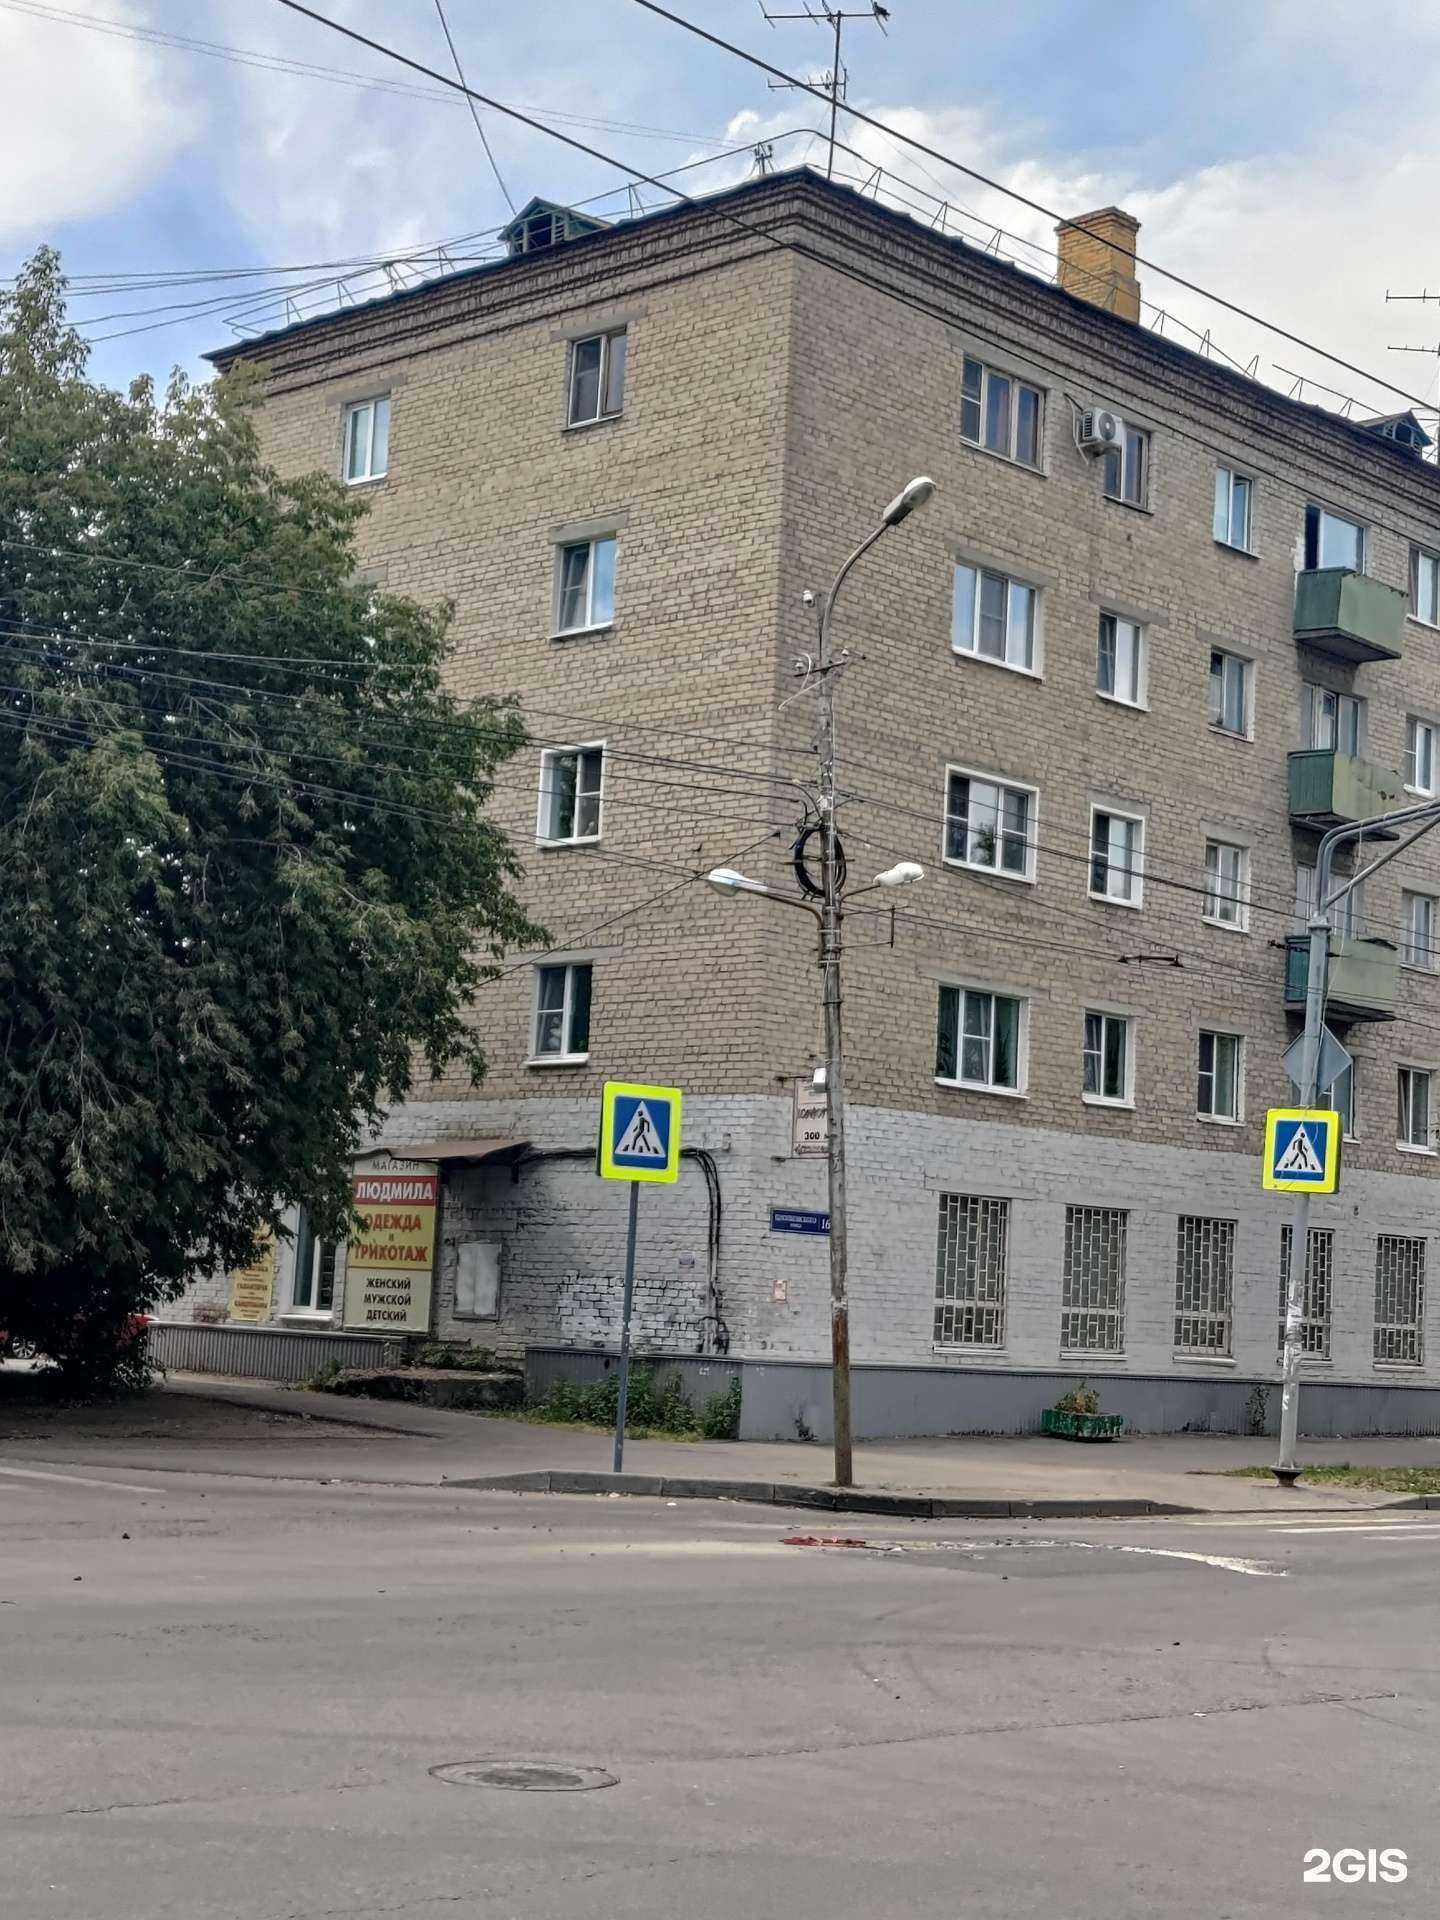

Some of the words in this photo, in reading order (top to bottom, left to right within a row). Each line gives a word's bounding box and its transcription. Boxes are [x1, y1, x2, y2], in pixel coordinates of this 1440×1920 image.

[804, 1131, 820, 1140] 300
[371, 1159, 418, 1171] МАГАЗИН
[356, 1182, 433, 1202] ЛЮДМИЛА
[363, 1213, 421, 1232] ОДЕЖДА
[821, 1218, 831, 1229] 16
[352, 1243, 427, 1261] ТРИКОТАЖ
[366, 1277, 411, 1289] ЖЕНСКИЙ
[364, 1293, 411, 1305] МУЖСКОЙ
[366, 1309, 407, 1321] ДЕТСКИЙ
